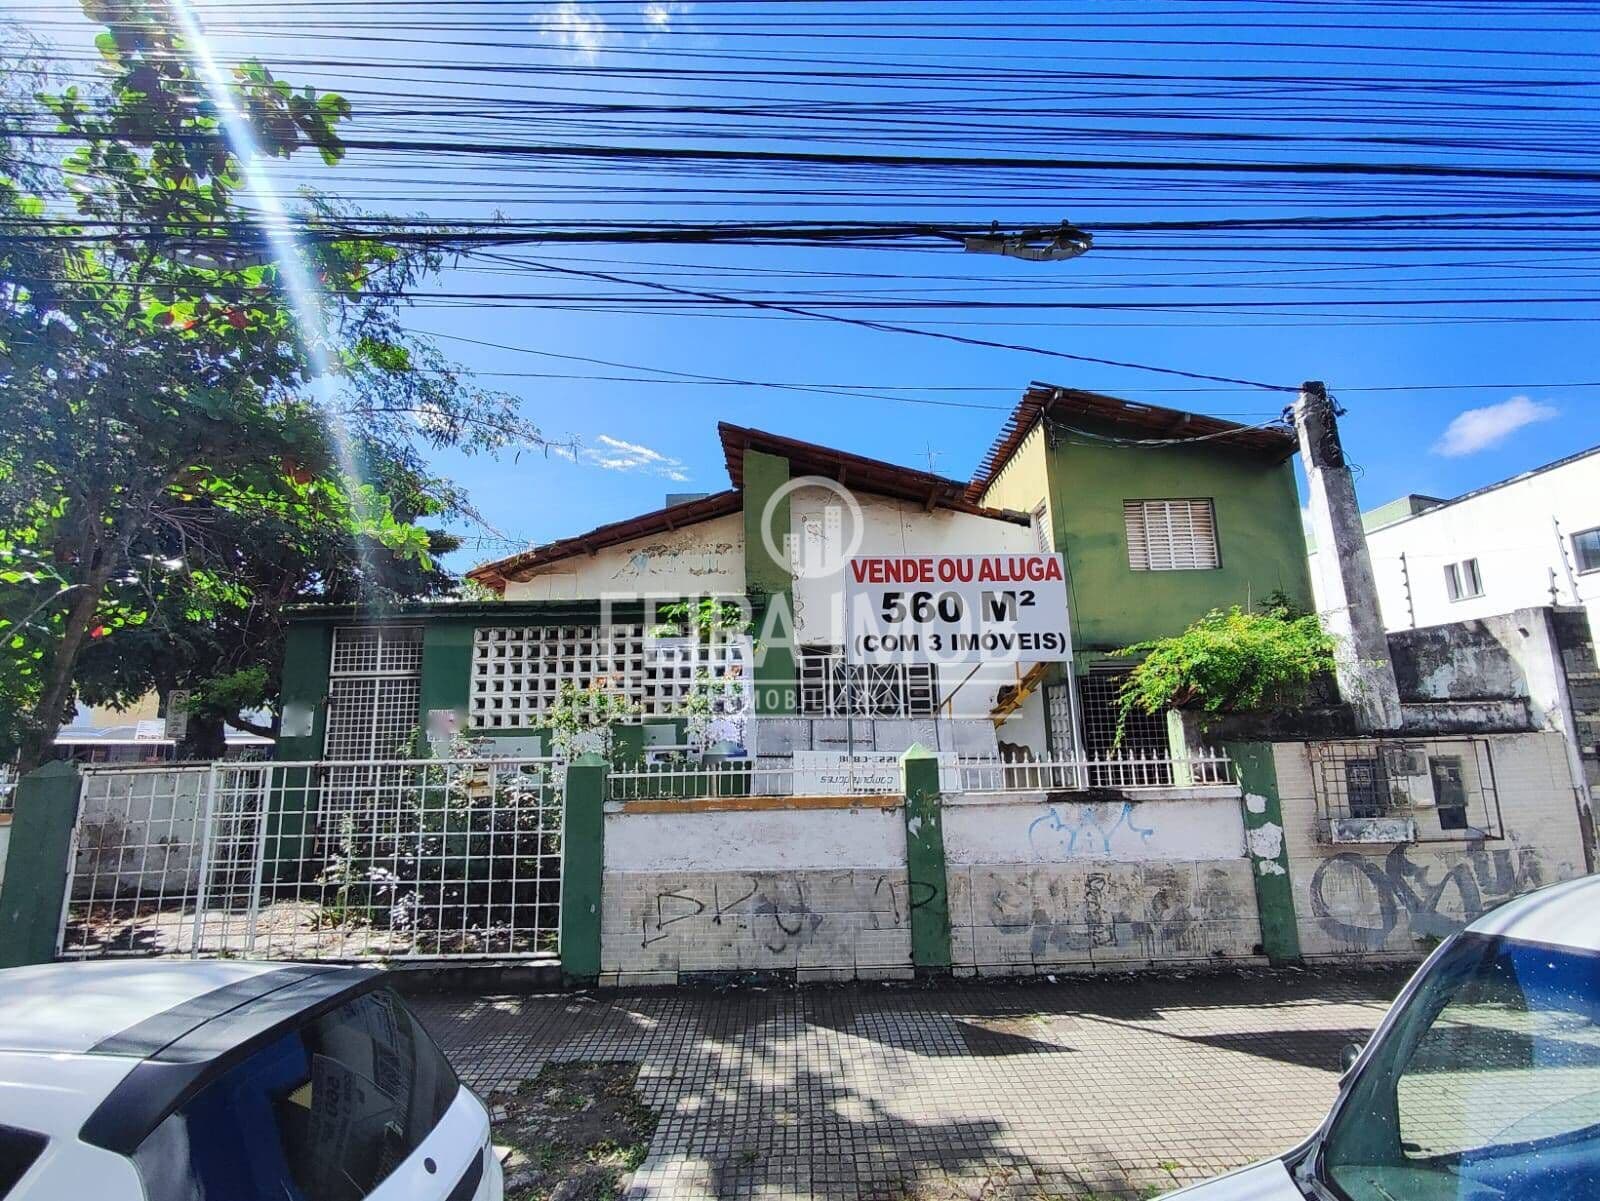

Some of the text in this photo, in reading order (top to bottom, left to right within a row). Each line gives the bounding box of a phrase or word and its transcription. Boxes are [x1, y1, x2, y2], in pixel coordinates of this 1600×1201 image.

[851, 557, 1063, 583] VENDE OU ALUGA
[881, 590, 1036, 623] 560 M²
[855, 630, 1066, 656] (COM 3 IMÓVEIS)
